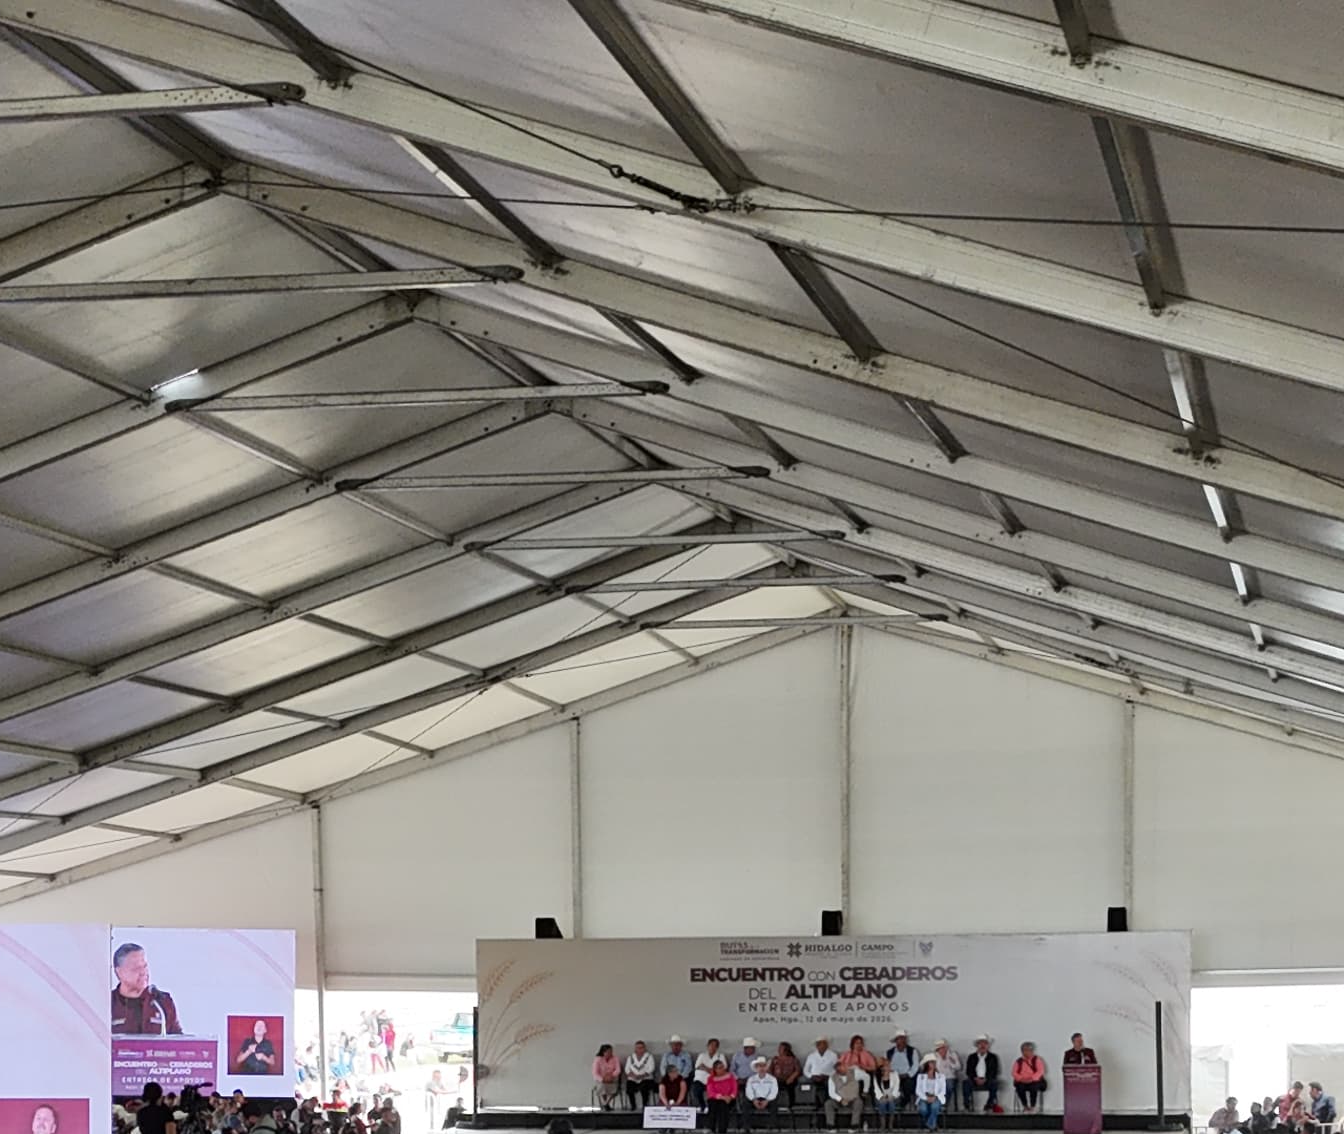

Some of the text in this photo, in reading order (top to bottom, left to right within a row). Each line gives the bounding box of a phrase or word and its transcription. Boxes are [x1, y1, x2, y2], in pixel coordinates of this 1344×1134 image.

[805, 944, 852, 952] HIDALGO
[861, 944, 894, 952] CAMPO
[690, 966, 958, 983] ENCUENTRO CON CEBADEROS
[748, 983, 898, 1000] DEL ALTIPLANO
[739, 1002, 910, 1013] ENTREGA DE APOYOS
